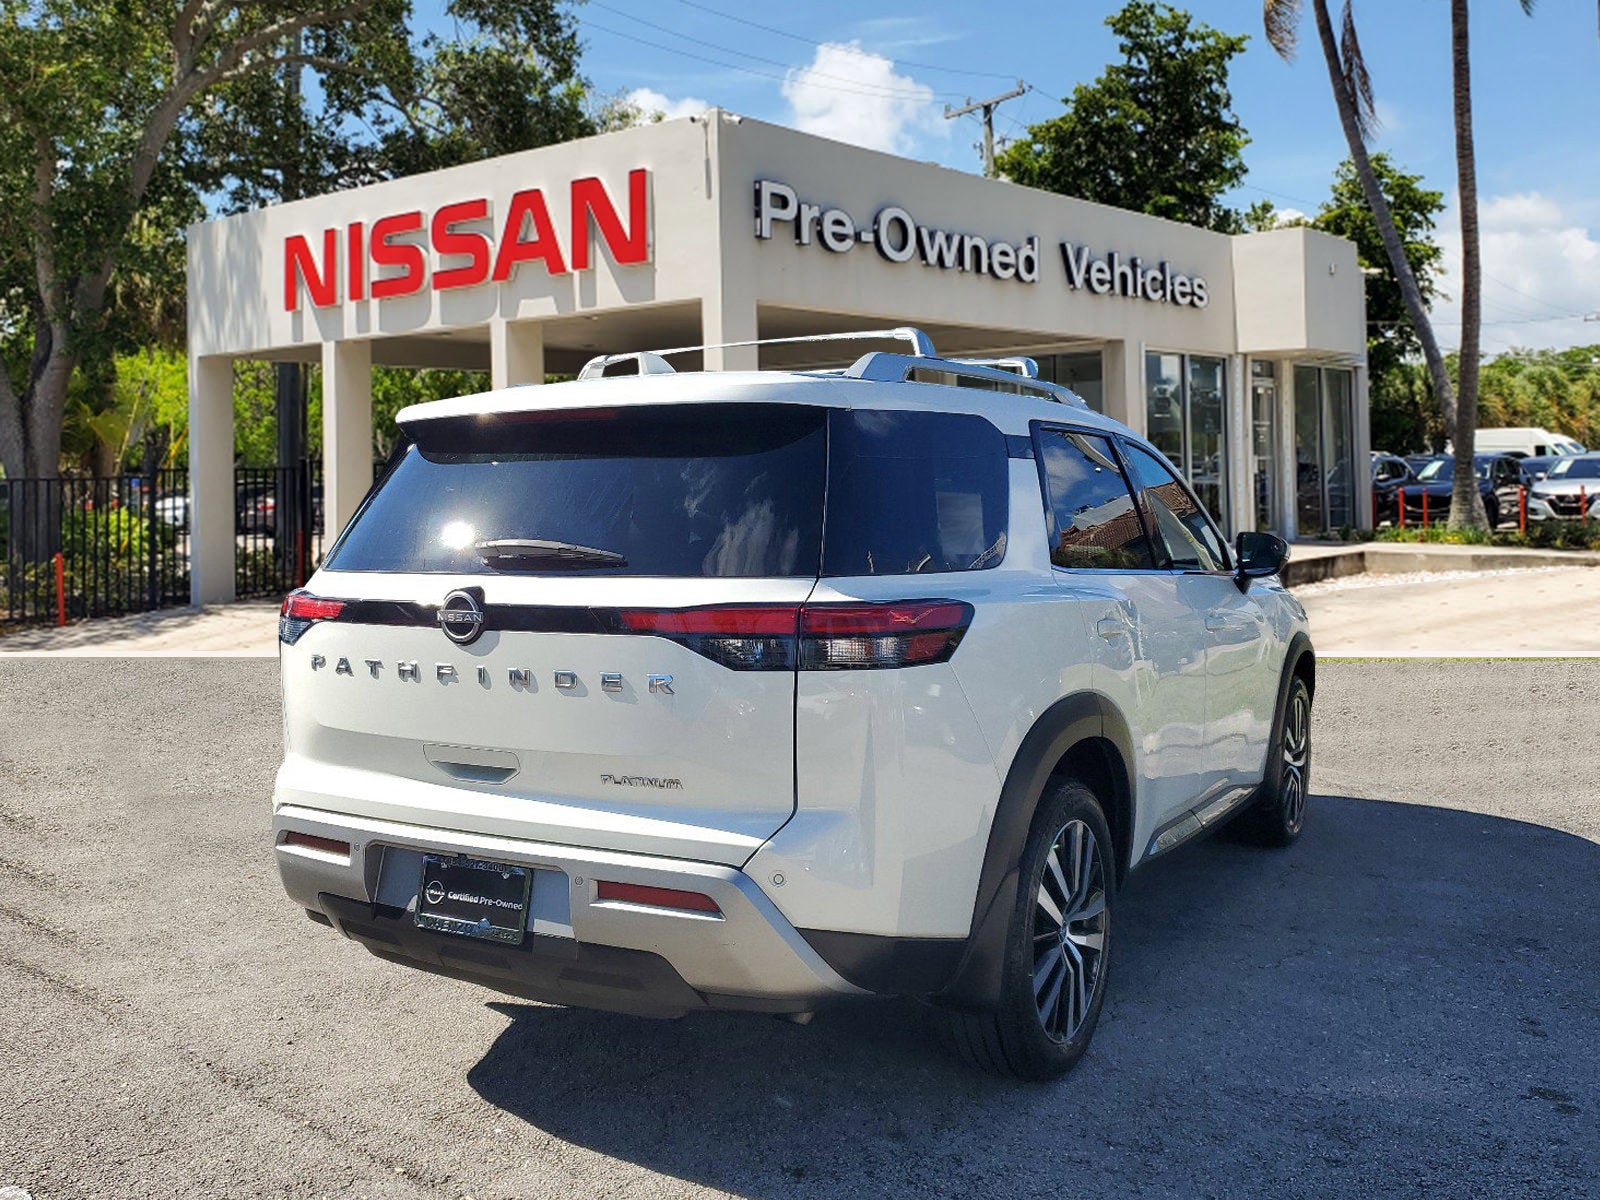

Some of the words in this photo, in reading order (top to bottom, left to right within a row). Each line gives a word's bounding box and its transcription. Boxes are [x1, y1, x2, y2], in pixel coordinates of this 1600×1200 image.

[285, 168, 647, 312] NISSAN
[754, 180, 1040, 284] Pre-Owned
[1060, 241, 1209, 309] Vehicles
[437, 611, 482, 623] NISSAN
[310, 653, 676, 696] PATHFINDER
[600, 774, 684, 790] PLATINUM
[447, 891, 479, 904] Certified
[479, 896, 523, 911] Pre-Owned
